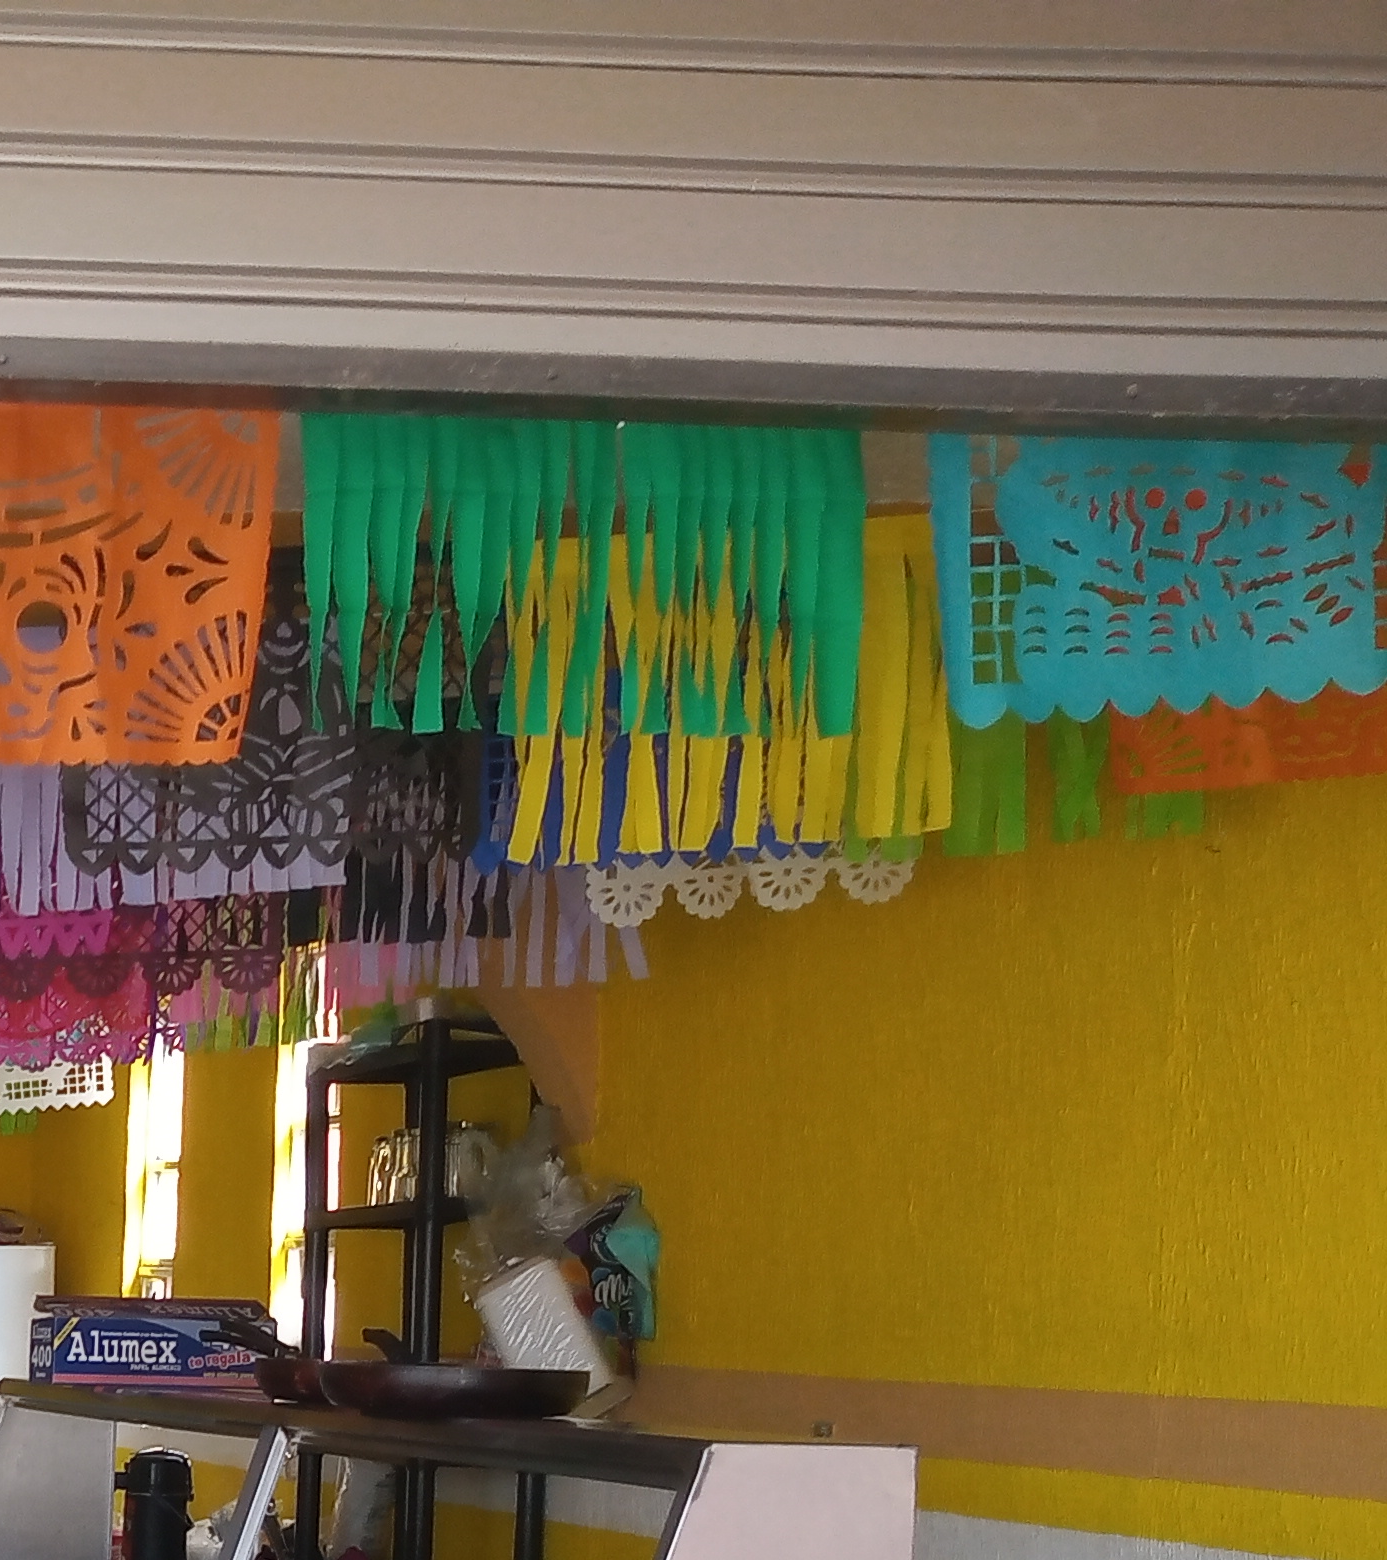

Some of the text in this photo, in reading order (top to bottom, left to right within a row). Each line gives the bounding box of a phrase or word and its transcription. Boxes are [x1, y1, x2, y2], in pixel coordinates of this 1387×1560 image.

[31, 1345, 52, 1368] 400
[66, 1330, 178, 1364] Alumex
[205, 1352, 252, 1370] regala
